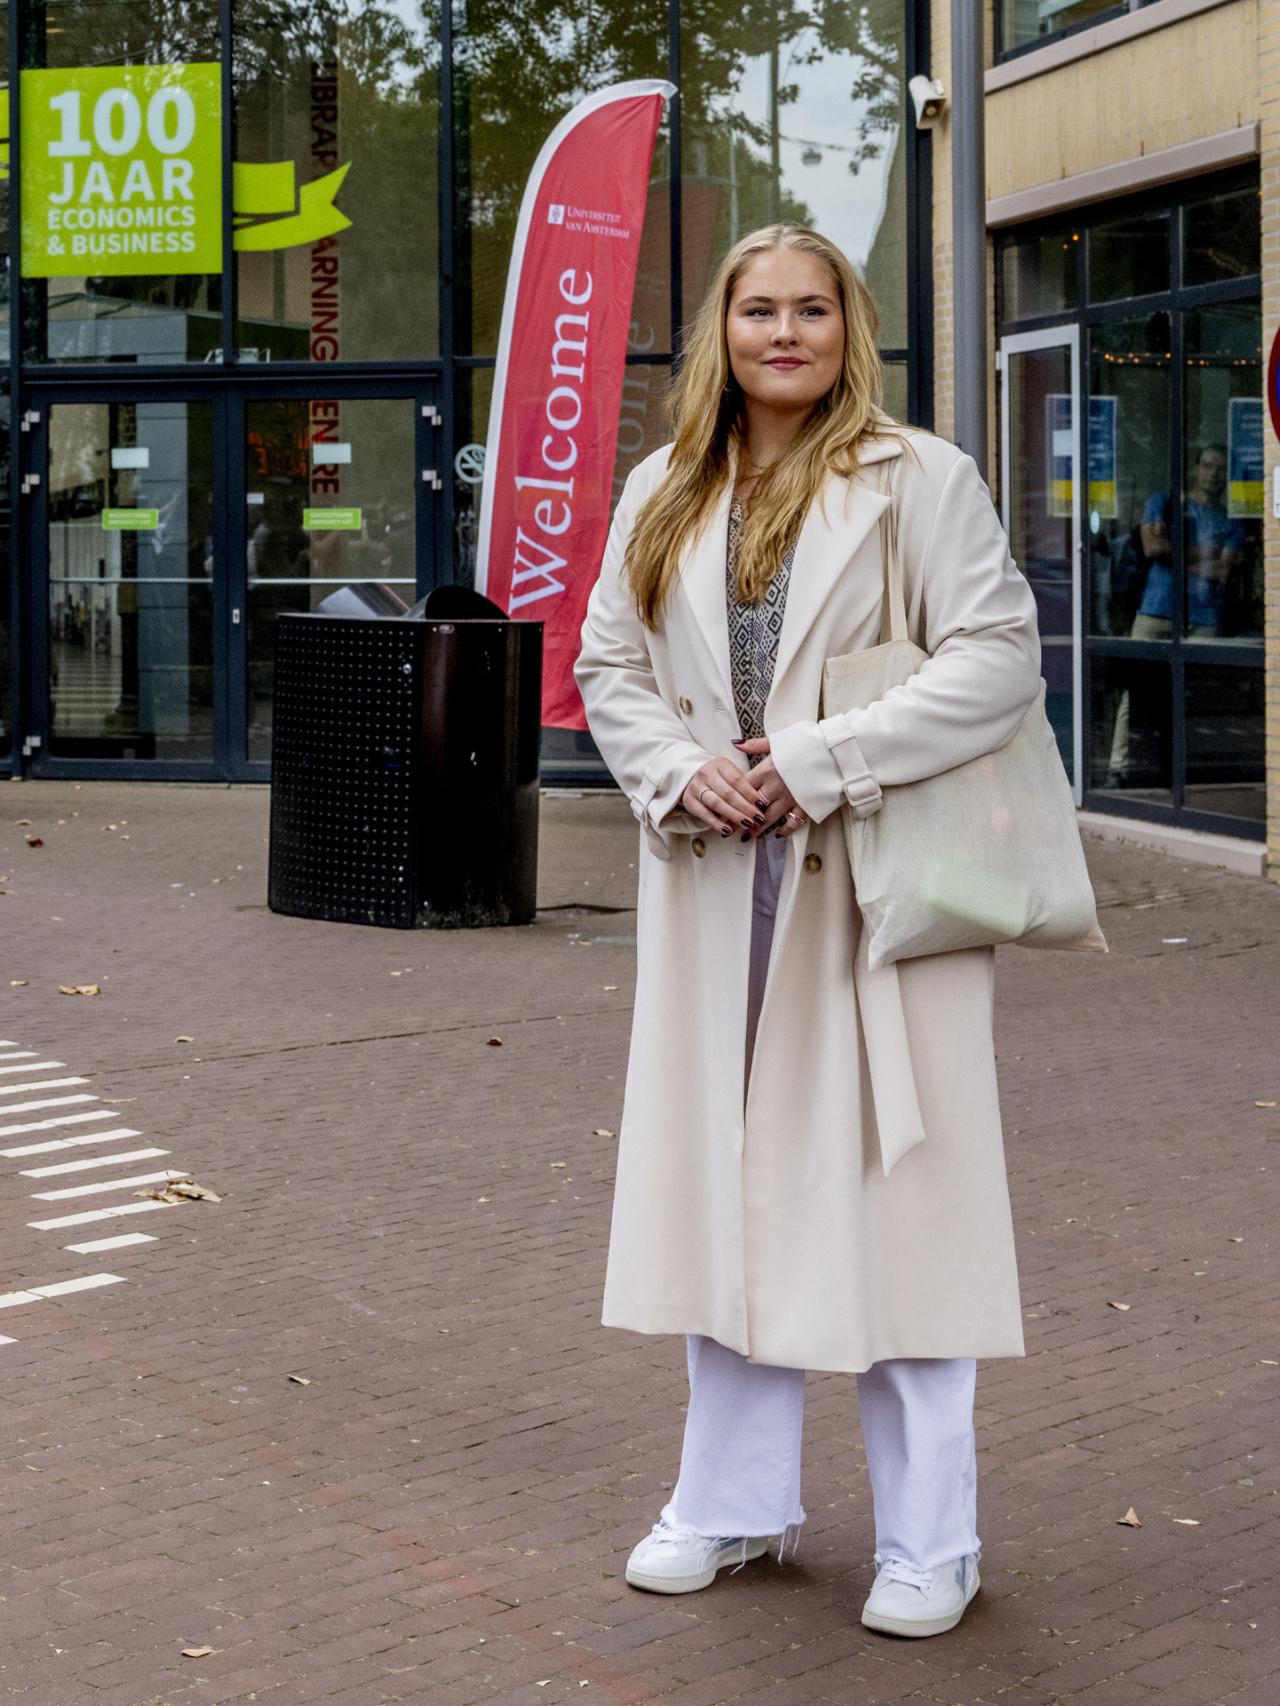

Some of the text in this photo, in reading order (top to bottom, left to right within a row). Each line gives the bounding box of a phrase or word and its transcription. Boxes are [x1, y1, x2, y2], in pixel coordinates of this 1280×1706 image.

[48, 87, 195, 157] 100
[311, 62, 338, 174] LIBRAR
[48, 159, 195, 204] JAAR
[48, 205, 196, 230] ECONOMICS
[47, 231, 196, 256] & BUSINESS
[311, 237, 338, 362] ARNING
[312, 401, 340, 494] ENRE
[508, 268, 593, 615] Welcome
